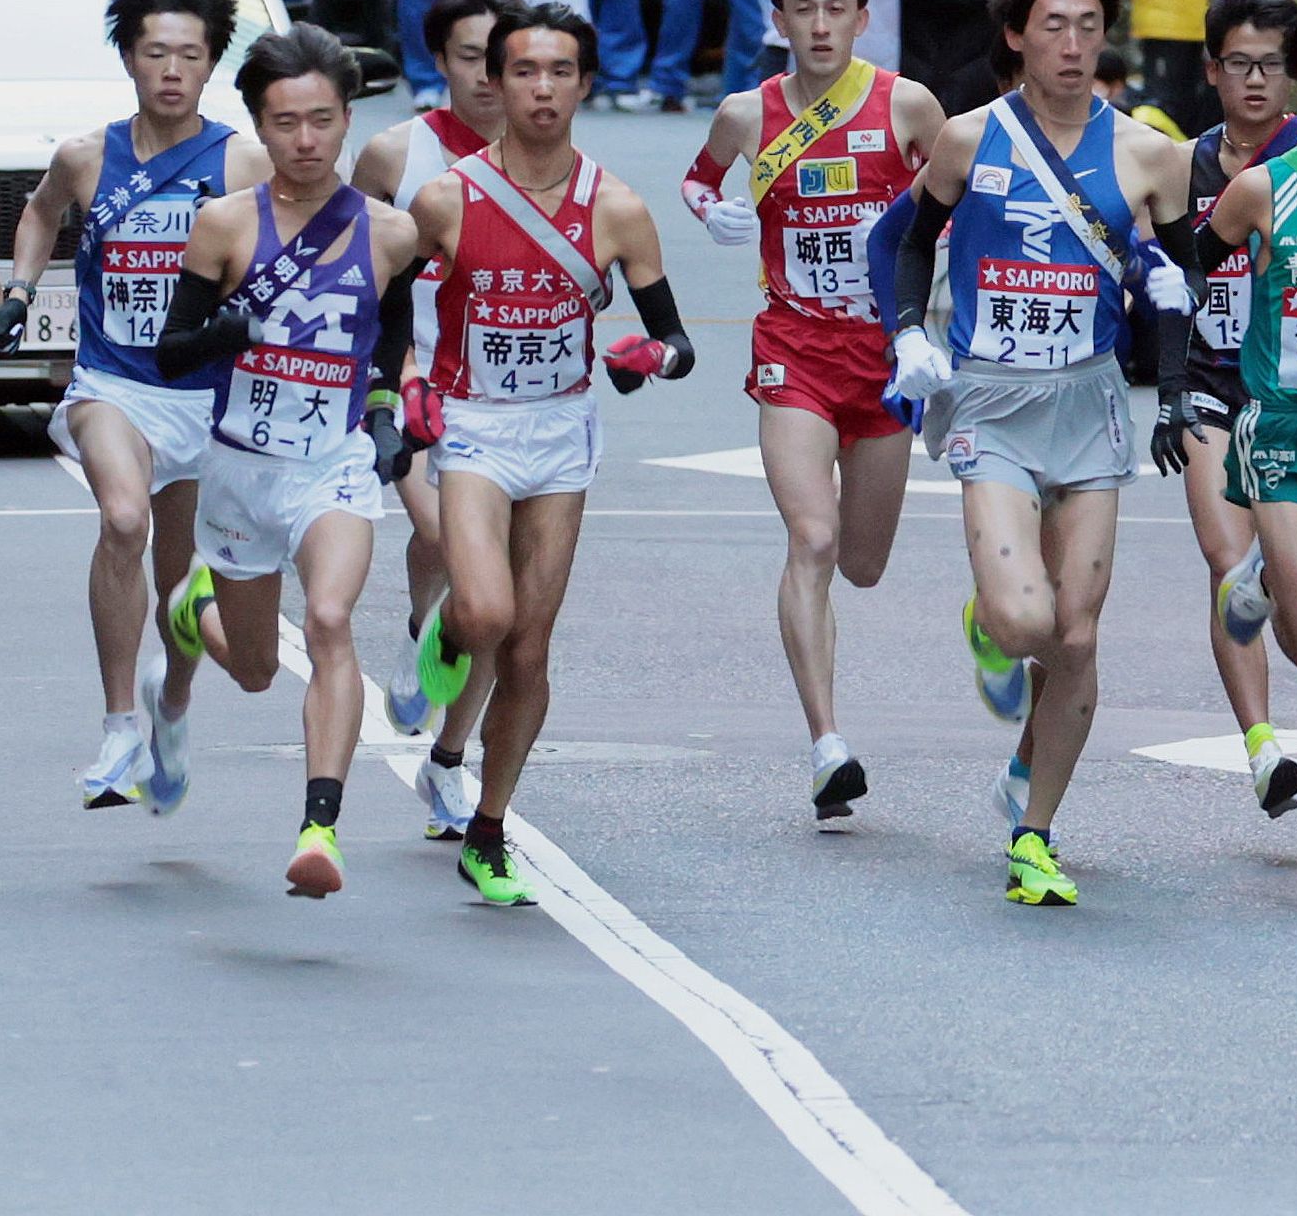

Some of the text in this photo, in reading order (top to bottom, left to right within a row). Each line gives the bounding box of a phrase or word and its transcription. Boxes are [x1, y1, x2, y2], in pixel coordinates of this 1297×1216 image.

[803, 201, 889, 224] SAPPORO
[1005, 268, 1095, 292] SAPPORO
[497, 298, 581, 324] SAPPORO
[989, 295, 1083, 335] 東海大
[483, 328, 573, 366] 帝京大
[997, 336, 1071, 366] 2-11
[262, 353, 351, 383] SAPPORO
[500, 369, 559, 393] 4-1
[252, 421, 312, 456] 6-1
